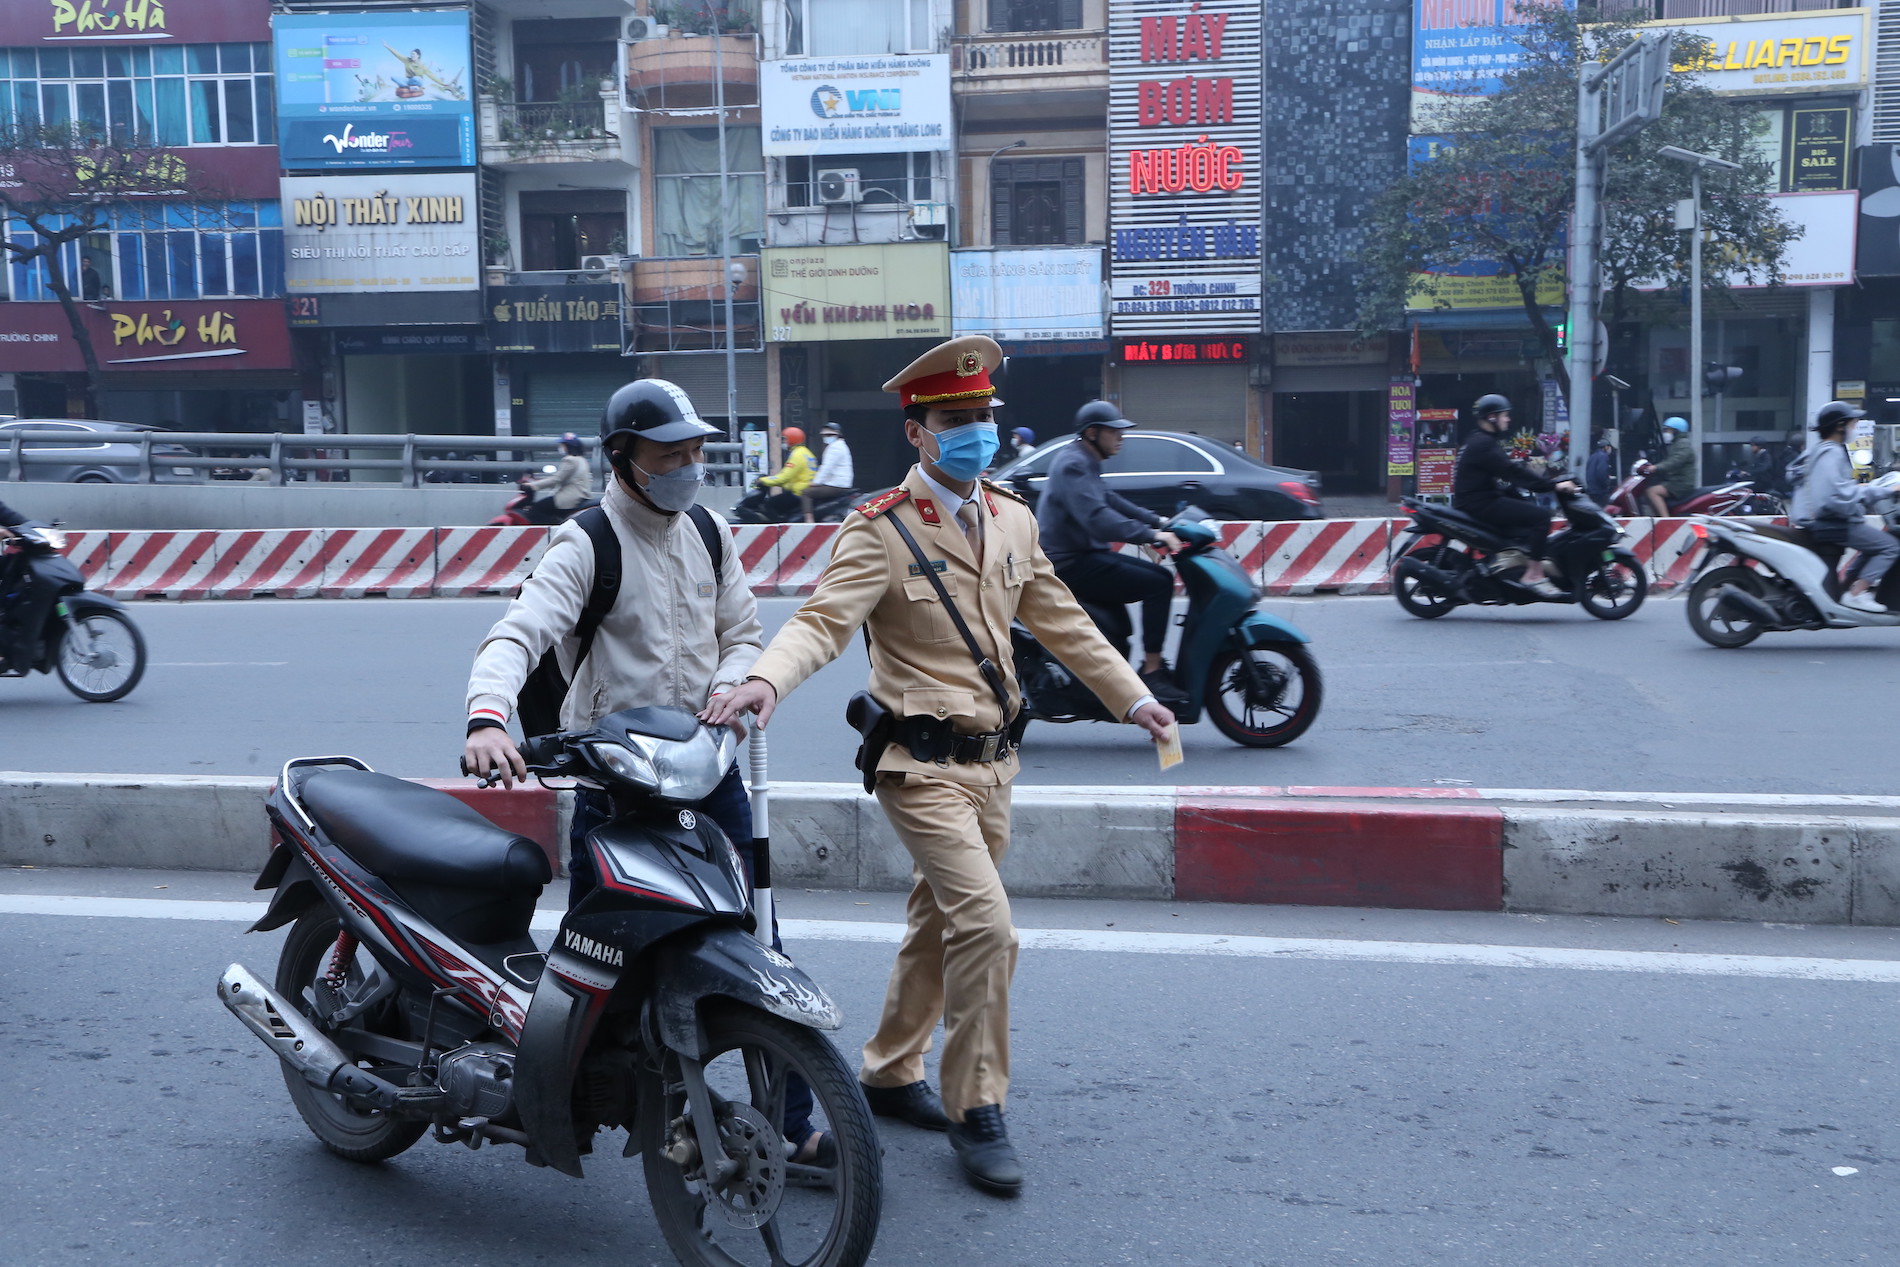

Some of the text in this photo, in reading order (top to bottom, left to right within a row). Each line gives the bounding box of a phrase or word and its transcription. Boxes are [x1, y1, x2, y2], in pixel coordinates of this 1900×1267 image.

[123, 0, 166, 31] Hà
[1140, 3, 1229, 62] MÁY
[845, 88, 901, 111] VNI
[1138, 75, 1233, 126] BƠM
[322, 123, 389, 153] Wonder
[770, 126, 791, 142] CÔNG
[792, 129, 801, 141] TY
[841, 124, 862, 139] HÀNG
[864, 123, 892, 138] KHÔNG
[921, 124, 942, 137] LONG
[1130, 135, 1243, 194] NƯỚC
[1801, 157, 1837, 167] SALE
[294, 189, 463, 232] NỘI THẤT XINH
[291, 242, 470, 261] SIÊU THỊ NỘI THẤT CAO CẤP
[789, 257, 825, 265] onplaza
[827, 269, 848, 277] DINH
[1148, 280, 1170, 295] 329
[1209, 283, 1236, 294] CHINH
[291, 297, 319, 316] 321
[514, 294, 562, 321] TUẤN
[566, 296, 598, 320] TÁO
[780, 301, 816, 325] YẾN
[823, 305, 887, 323] KHÁNH
[33, 334, 58, 342] CHINH
[111, 310, 238, 345] Phủ Hà
[772, 327, 792, 341] 327
[1391, 386, 1411, 396] HOA
[564, 928, 624, 967] YAMAHA
